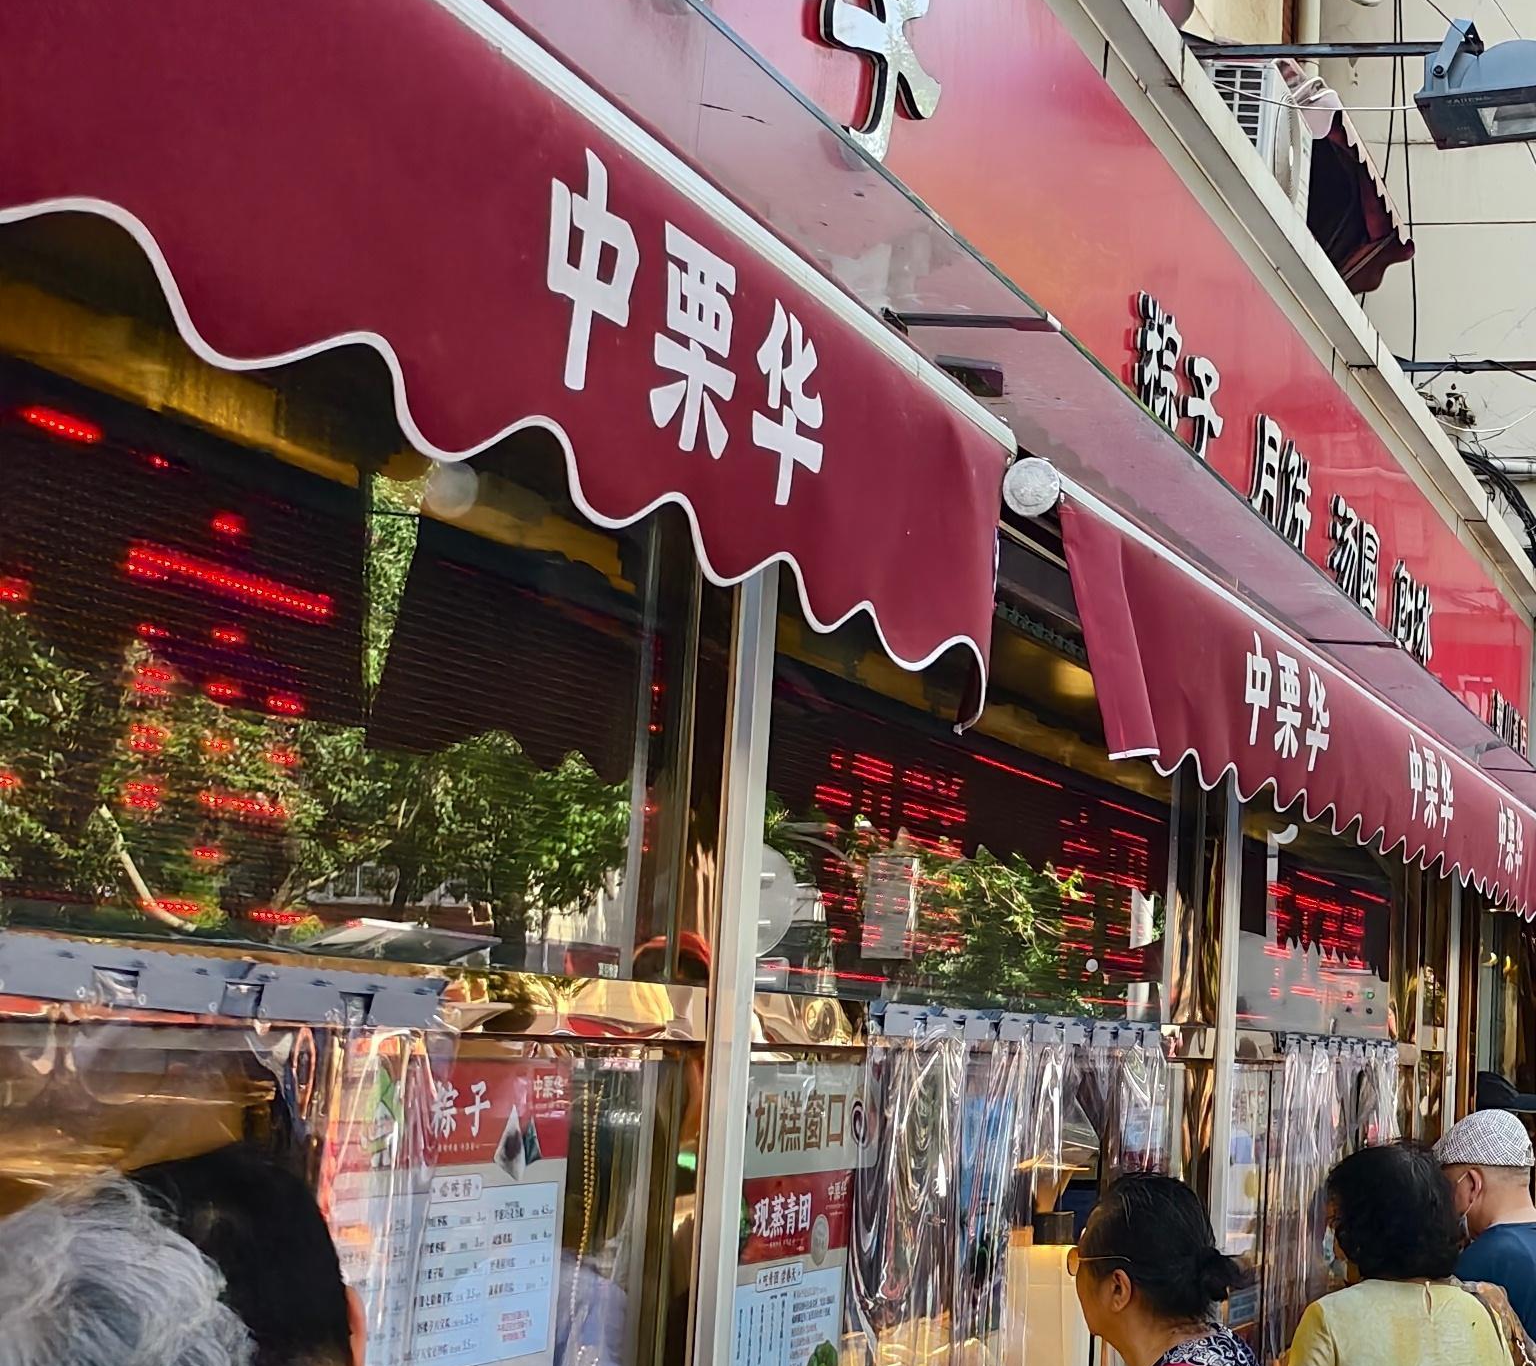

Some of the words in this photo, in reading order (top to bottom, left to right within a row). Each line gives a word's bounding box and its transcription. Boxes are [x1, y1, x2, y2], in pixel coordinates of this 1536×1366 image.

[546, 147, 825, 506] 中栗华
[1135, 289, 1224, 459] 粽子
[1249, 413, 1313, 554] 月饼
[1326, 493, 1381, 617] 汤圆
[1244, 631, 1330, 772] 中栗华
[1409, 733, 1454, 838] 中栗华
[1498, 797, 1524, 881] 中栗华
[430, 1081, 492, 1139] 粽子
[755, 1090, 847, 1155] 切糕窗口
[753, 1191, 813, 1238] 现蒸青团
